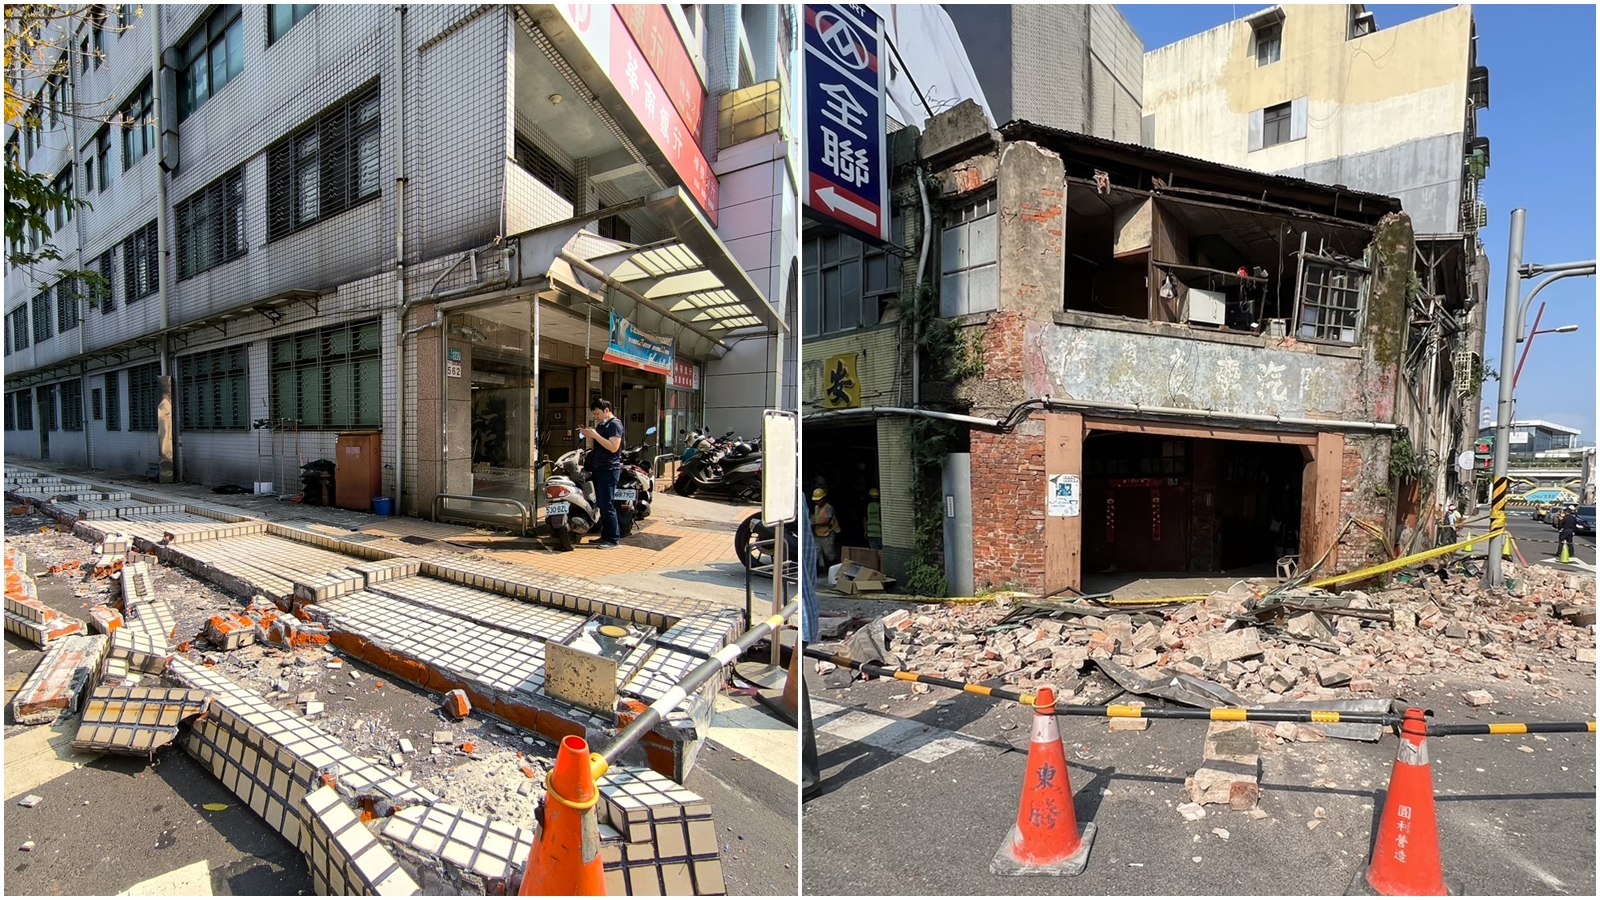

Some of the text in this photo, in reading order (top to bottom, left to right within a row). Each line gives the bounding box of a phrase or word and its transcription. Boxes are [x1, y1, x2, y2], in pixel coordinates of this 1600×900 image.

[625, 48, 683, 160] 華南銀行
[819, 83, 870, 188] 全聯
[447, 366, 461, 376] 562
